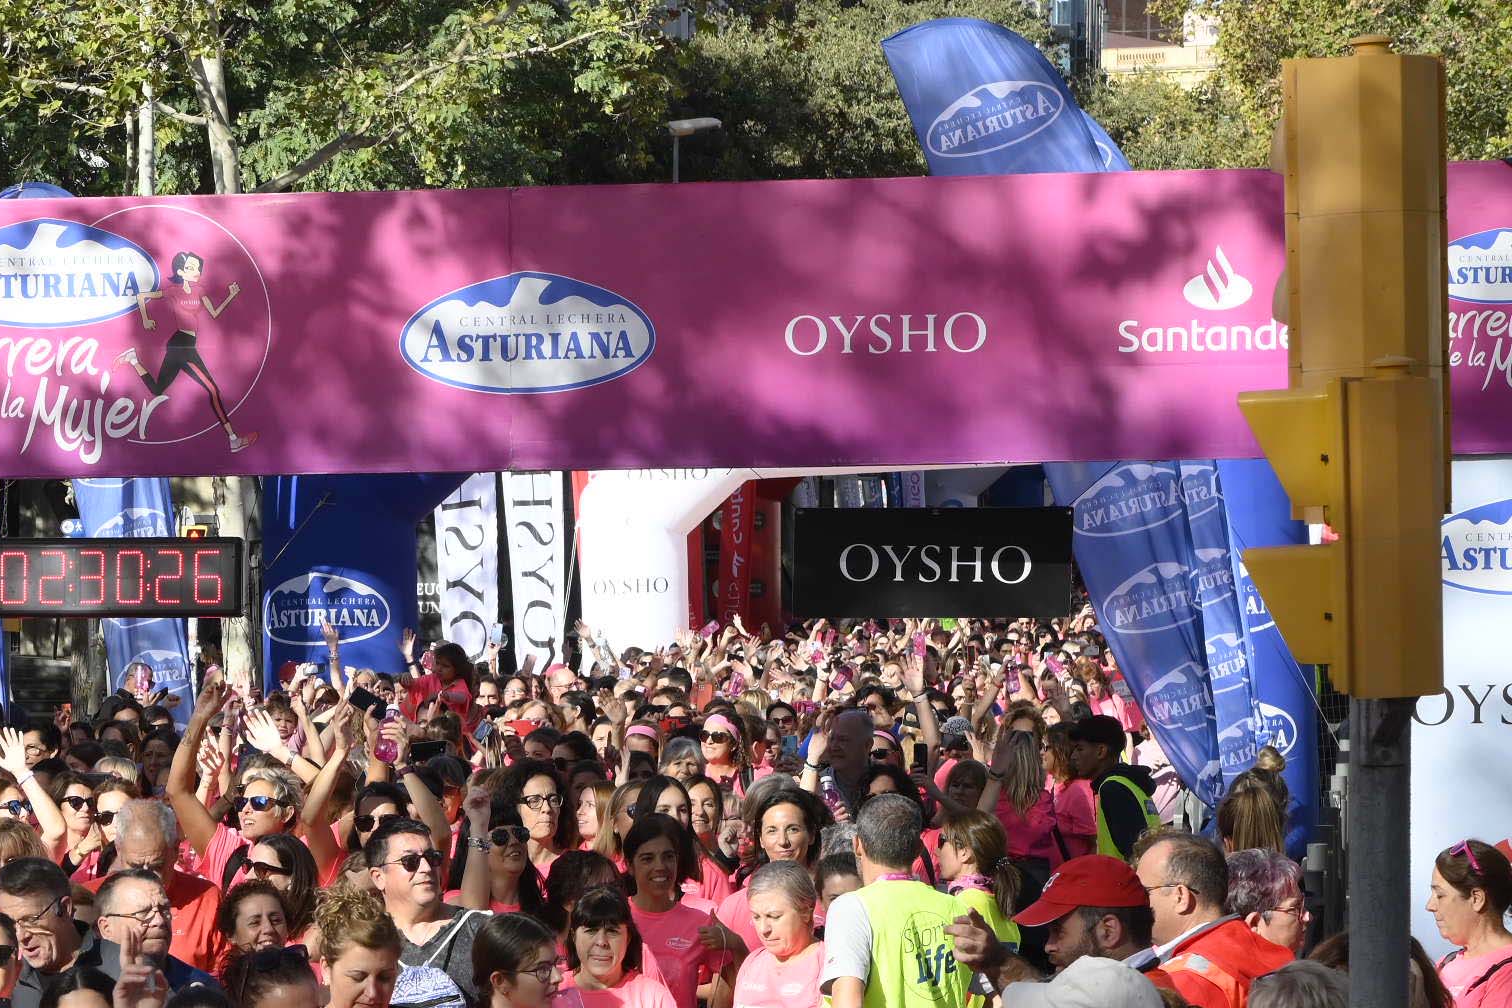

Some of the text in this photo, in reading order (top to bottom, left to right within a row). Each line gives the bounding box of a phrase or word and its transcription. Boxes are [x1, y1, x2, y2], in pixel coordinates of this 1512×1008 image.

[419, 318, 637, 364] ASTURIANA
[458, 312, 628, 327] CENTRAL LECHERA
[784, 311, 988, 357] OYSHO
[0, 377, 25, 419] la
[20, 369, 170, 465] Mujer
[0, 549, 223, 605] 02:30:26
[838, 542, 1033, 584] OYSHO
[592, 575, 670, 597] OYSHO
[268, 604, 382, 630] ASTURIANA
[916, 943, 957, 987] life
